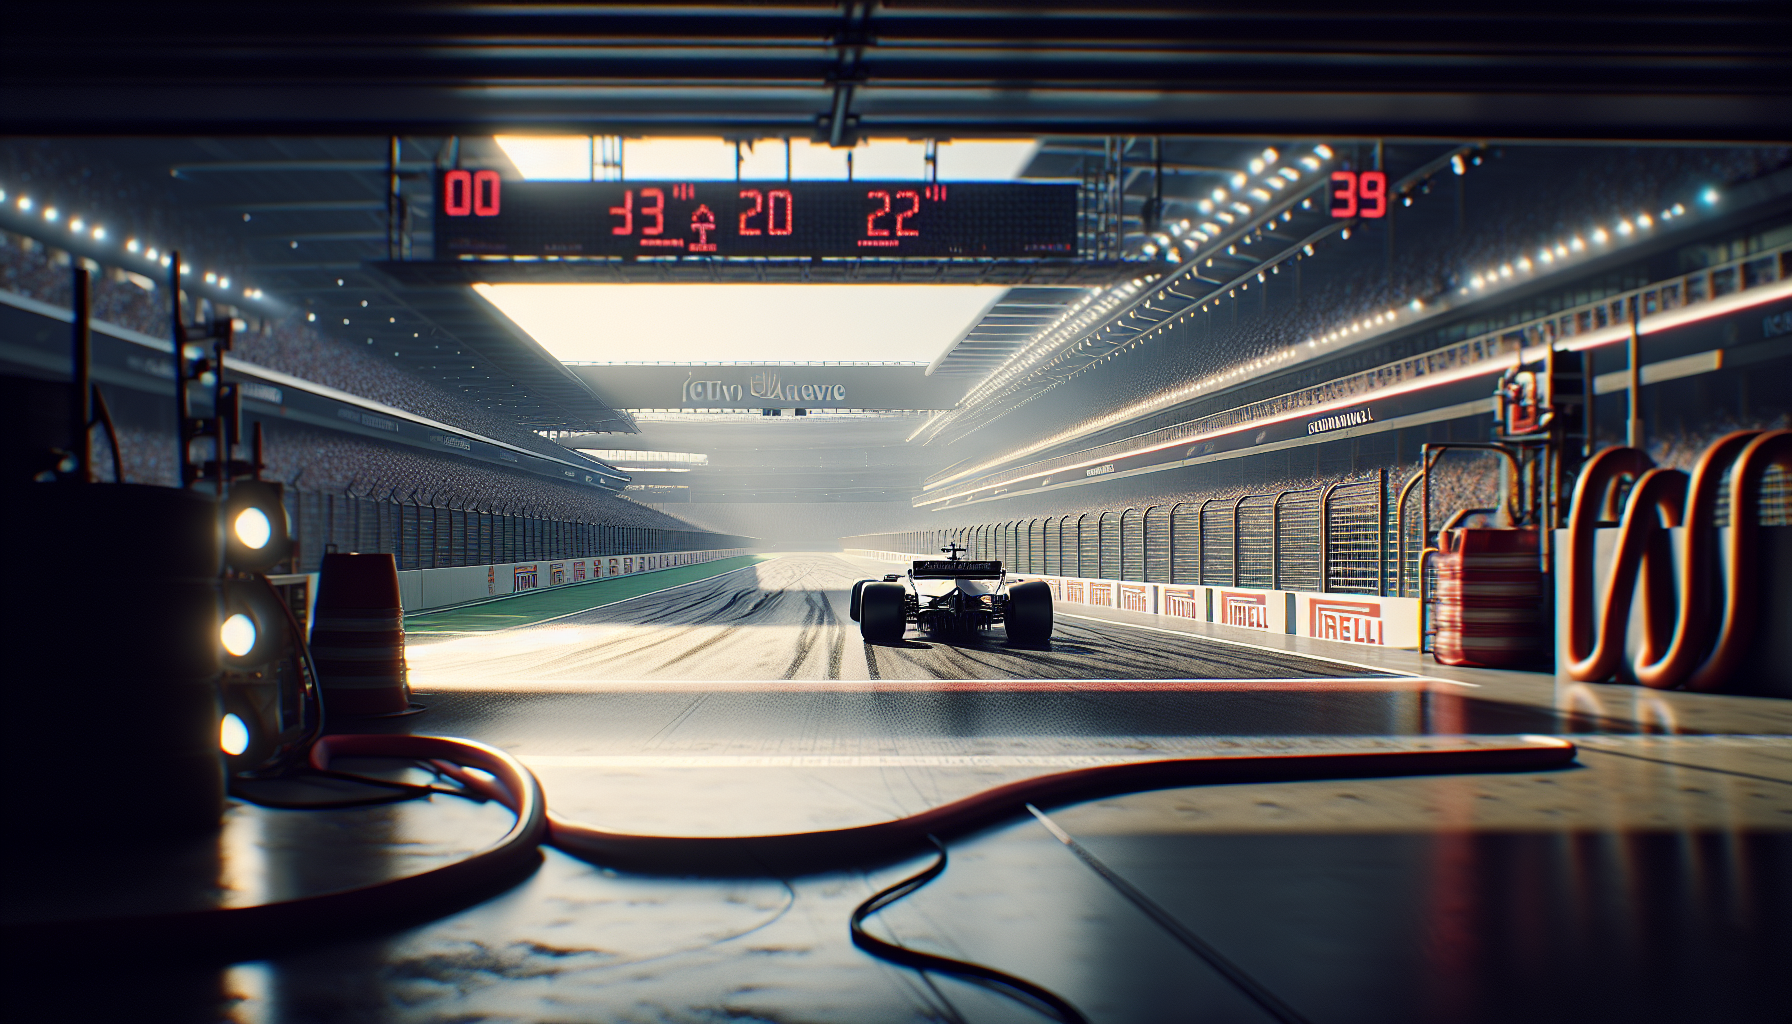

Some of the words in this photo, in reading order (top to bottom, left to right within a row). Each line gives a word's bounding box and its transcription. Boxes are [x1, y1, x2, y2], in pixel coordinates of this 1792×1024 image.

[444, 169, 501, 217] 00
[738, 188, 793, 236] 20
[866, 190, 920, 237] 22
[1331, 171, 1387, 219] 39
